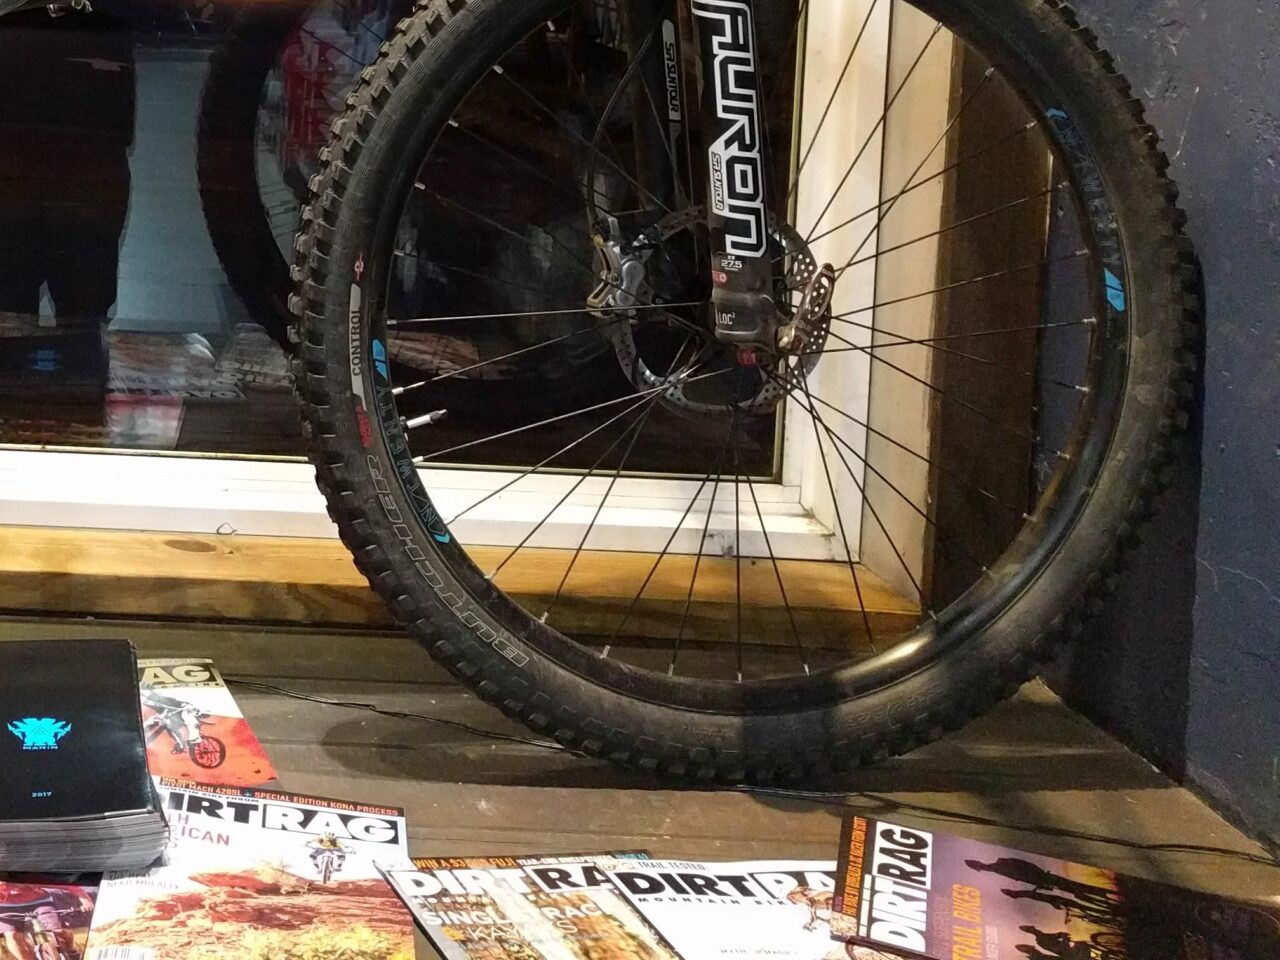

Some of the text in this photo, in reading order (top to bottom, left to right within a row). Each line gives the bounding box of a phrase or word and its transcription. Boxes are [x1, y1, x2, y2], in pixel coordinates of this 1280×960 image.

[712, 171, 724, 210] SUNTOUR
[352, 308, 361, 377] CONTROL
[366, 454, 529, 667] BUTCHER
[160, 791, 396, 843] IRT RAG
[188, 783, 214, 793] MACH
[254, 791, 291, 803] SPECIAL
[293, 796, 328, 807] EDITION
[330, 801, 354, 811] KONA
[357, 806, 399, 816] PROCESS
[414, 859, 439, 868] WIN
[490, 857, 517, 868] FUJI
[637, 861, 667, 870] TRAIL
[391, 869, 533, 897] DIRT
[614, 872, 757, 898] DIRT
[869, 828, 930, 953] DIRT RAG
[637, 897, 741, 906] MOUNTAIN
[952, 884, 982, 960] TRAIL BIKES
